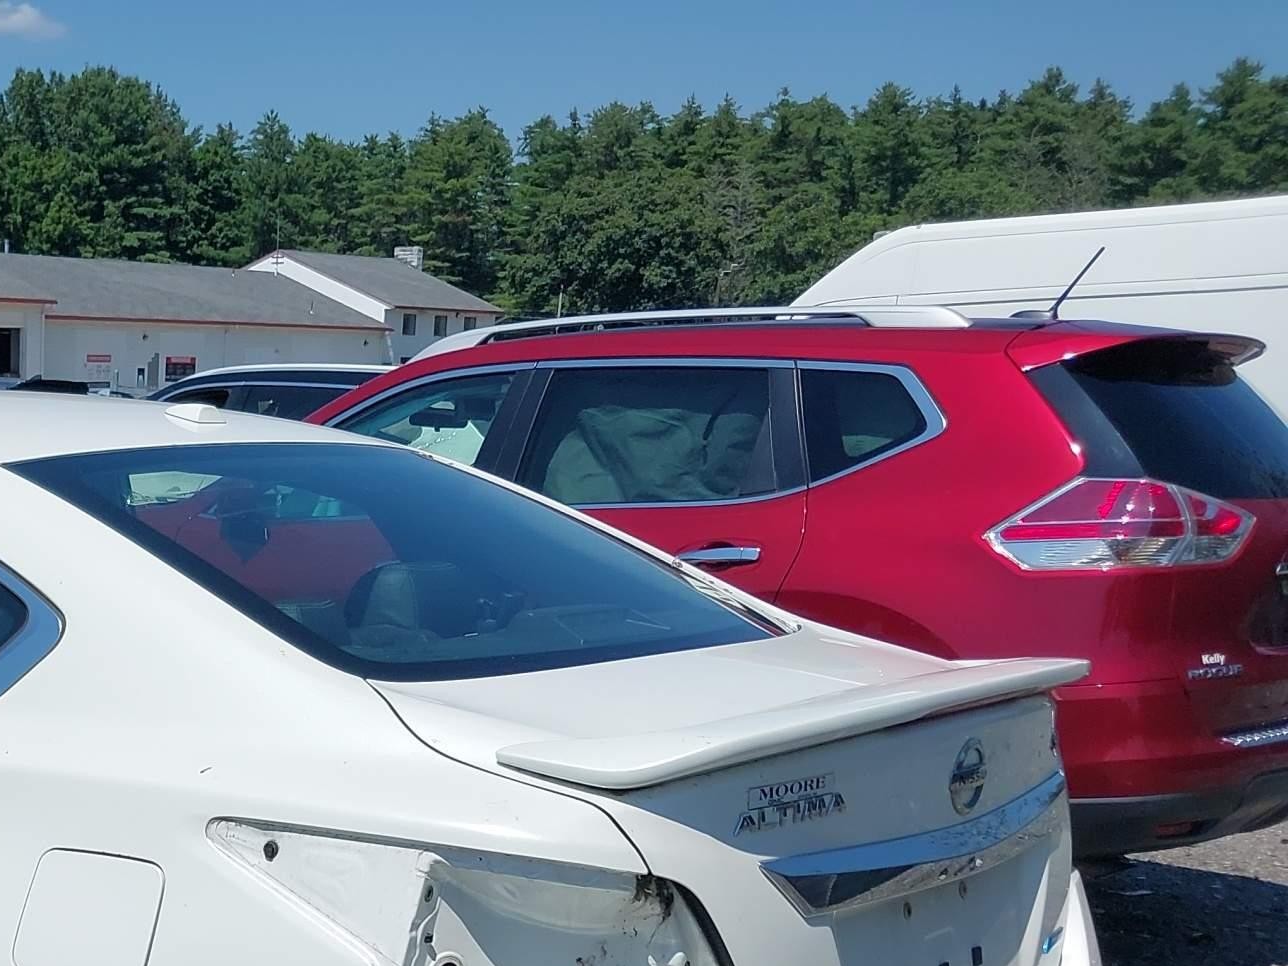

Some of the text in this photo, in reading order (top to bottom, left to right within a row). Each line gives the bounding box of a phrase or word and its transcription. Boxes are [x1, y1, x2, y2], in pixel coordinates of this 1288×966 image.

[1201, 653, 1225, 665] Kelly
[759, 776, 826, 801] MOORE
[734, 791, 846, 837] ALTIMA
